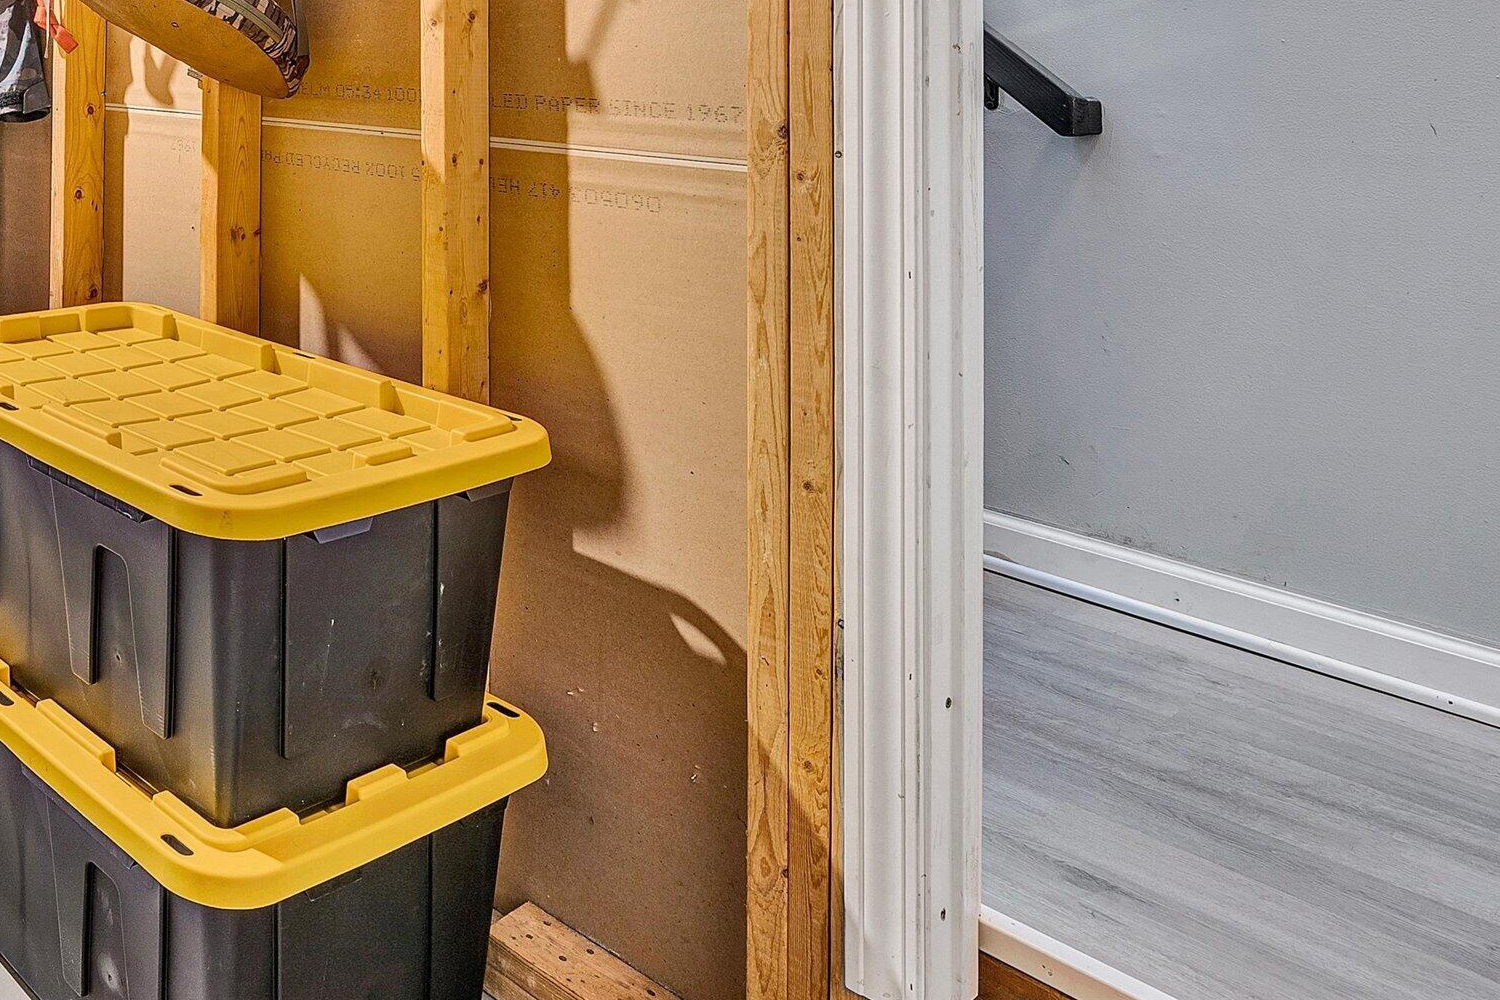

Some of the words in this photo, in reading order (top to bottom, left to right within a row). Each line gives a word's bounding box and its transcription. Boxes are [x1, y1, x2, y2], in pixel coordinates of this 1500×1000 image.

[387, 86, 421, 103] 100
[490, 93, 528, 110] LED
[534, 94, 601, 115] PAPER
[608, 99, 676, 120] SINCE
[686, 103, 745, 123] 1967
[285, 151, 361, 174] RECYCLED
